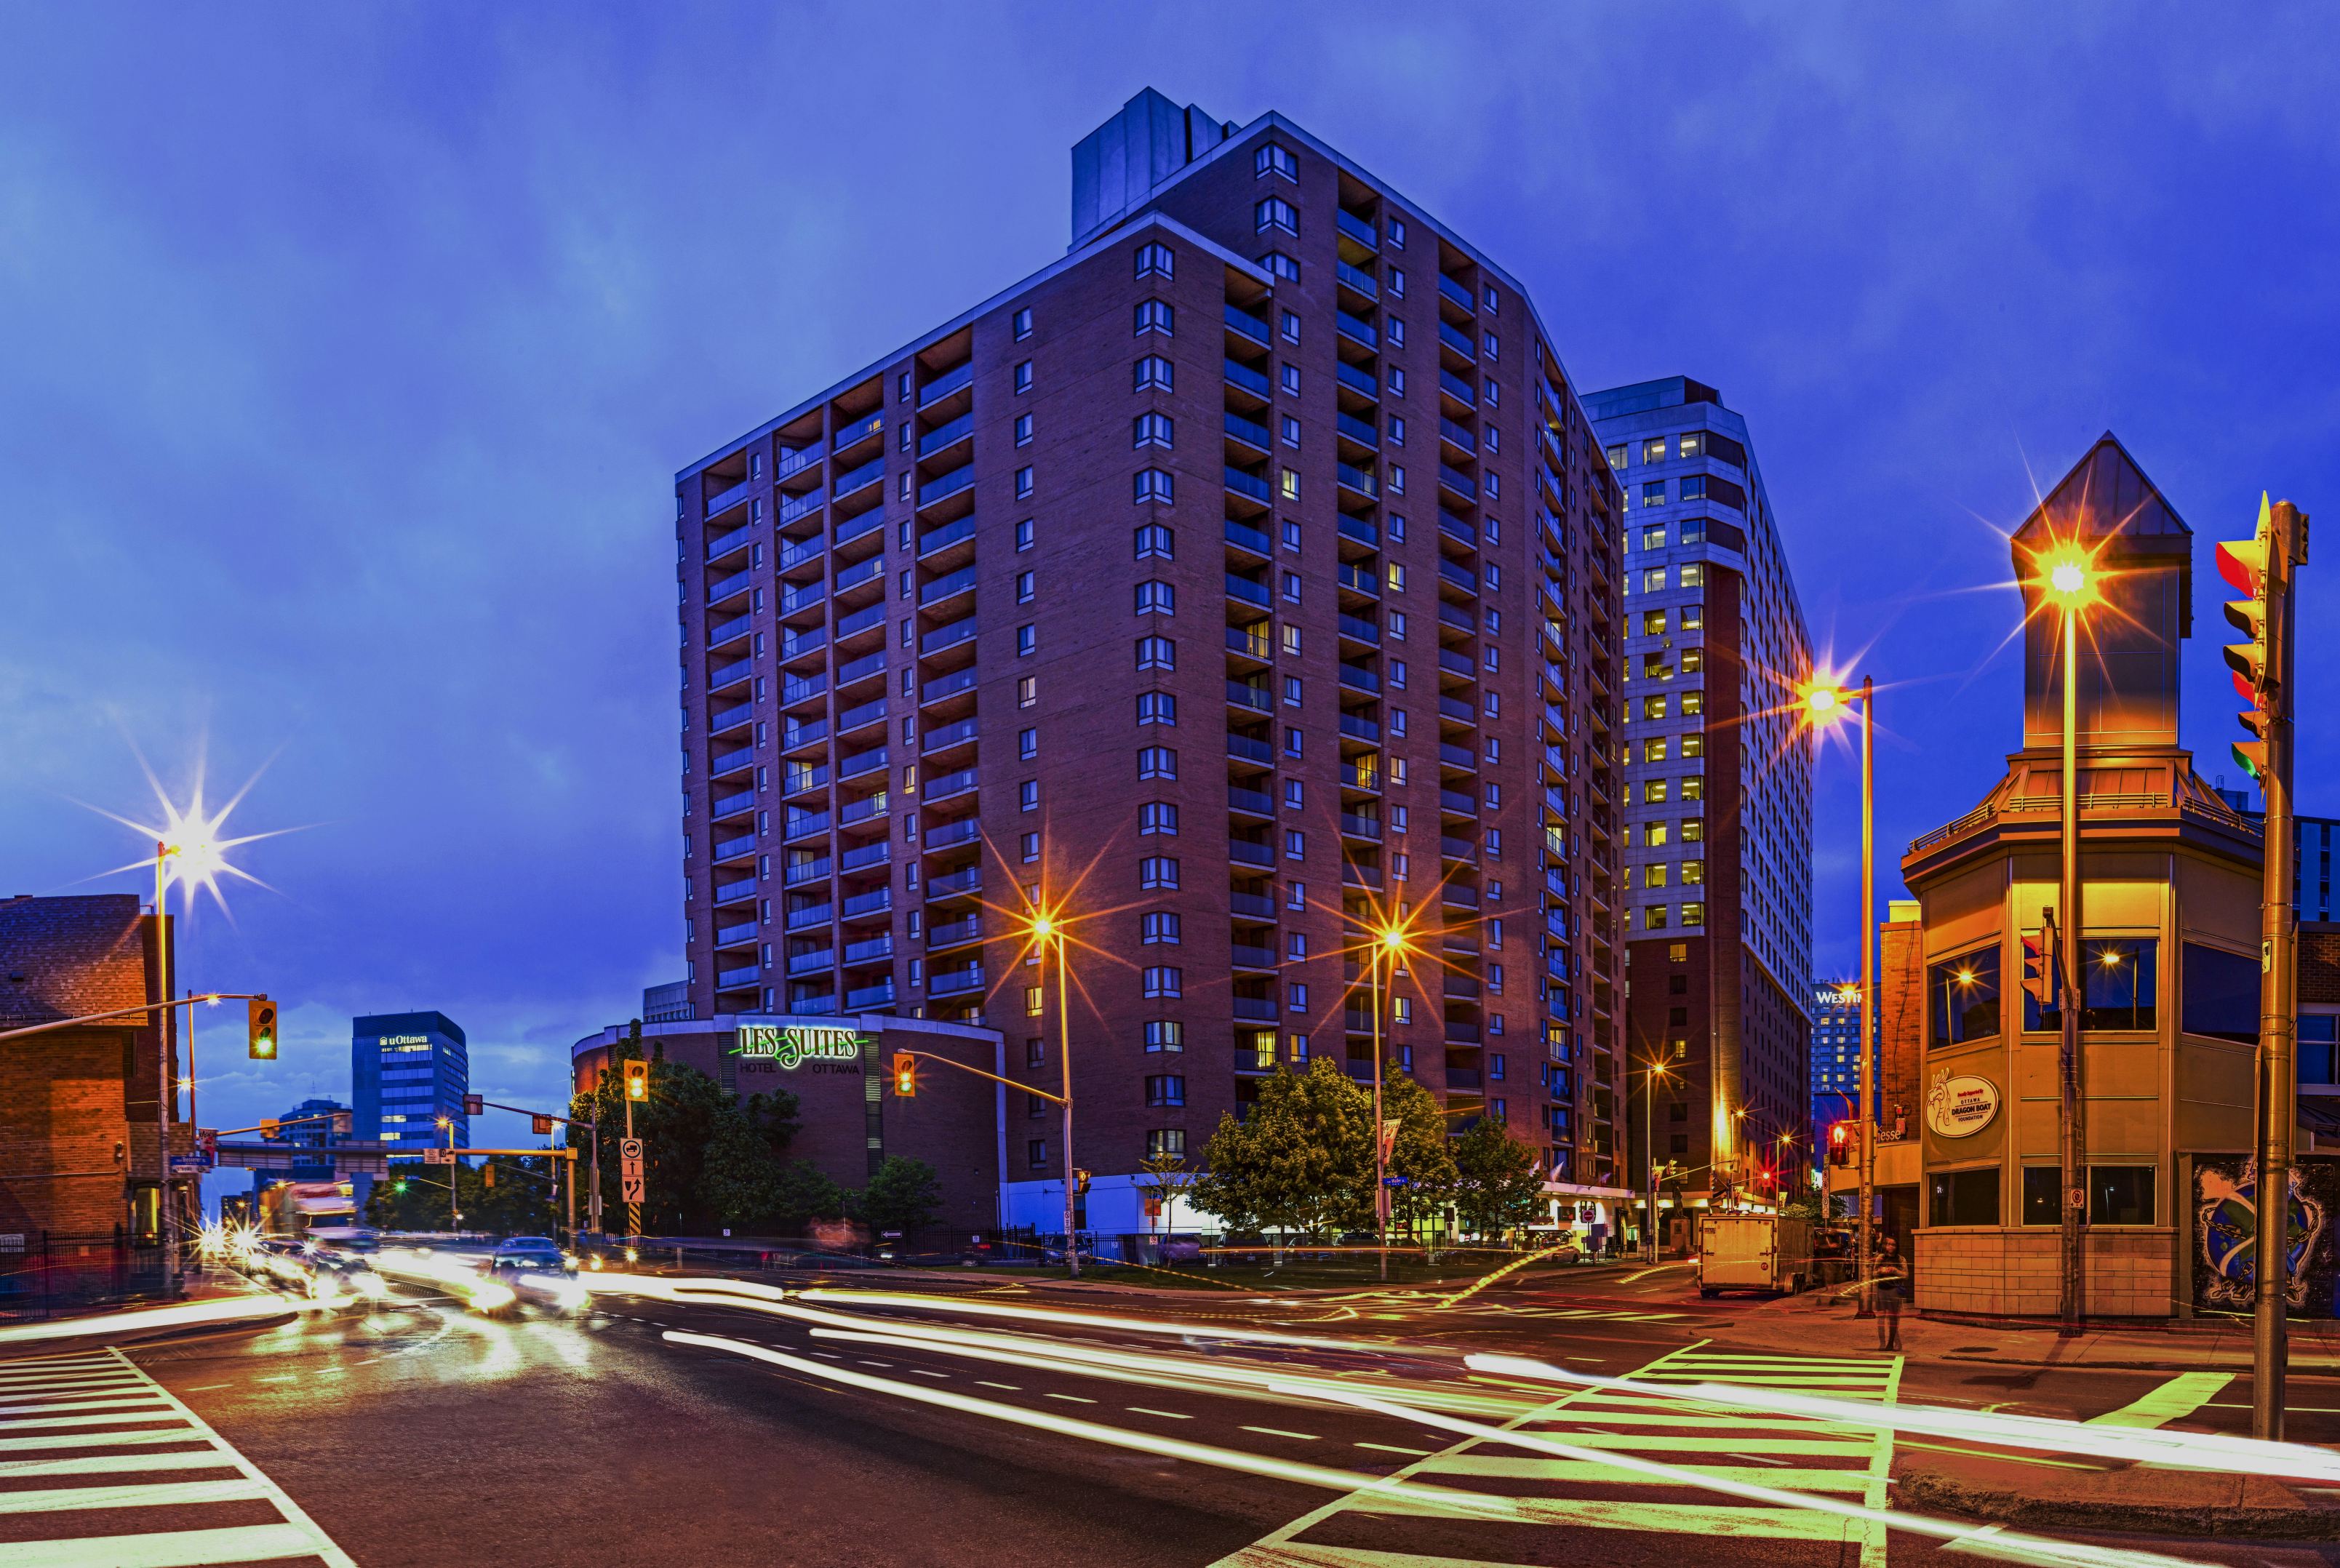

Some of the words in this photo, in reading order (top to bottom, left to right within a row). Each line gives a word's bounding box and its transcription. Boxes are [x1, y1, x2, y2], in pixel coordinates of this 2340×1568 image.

[389, 1035, 428, 1045] uOttawa
[741, 1028, 777, 1055] LES
[780, 1028, 856, 1067] SUITES
[740, 1063, 776, 1073] HOTEL
[812, 1064, 860, 1074] OTTAWA
[1952, 1105, 1975, 1115] DRAGON
[1976, 1103, 1992, 1111] BOAT
